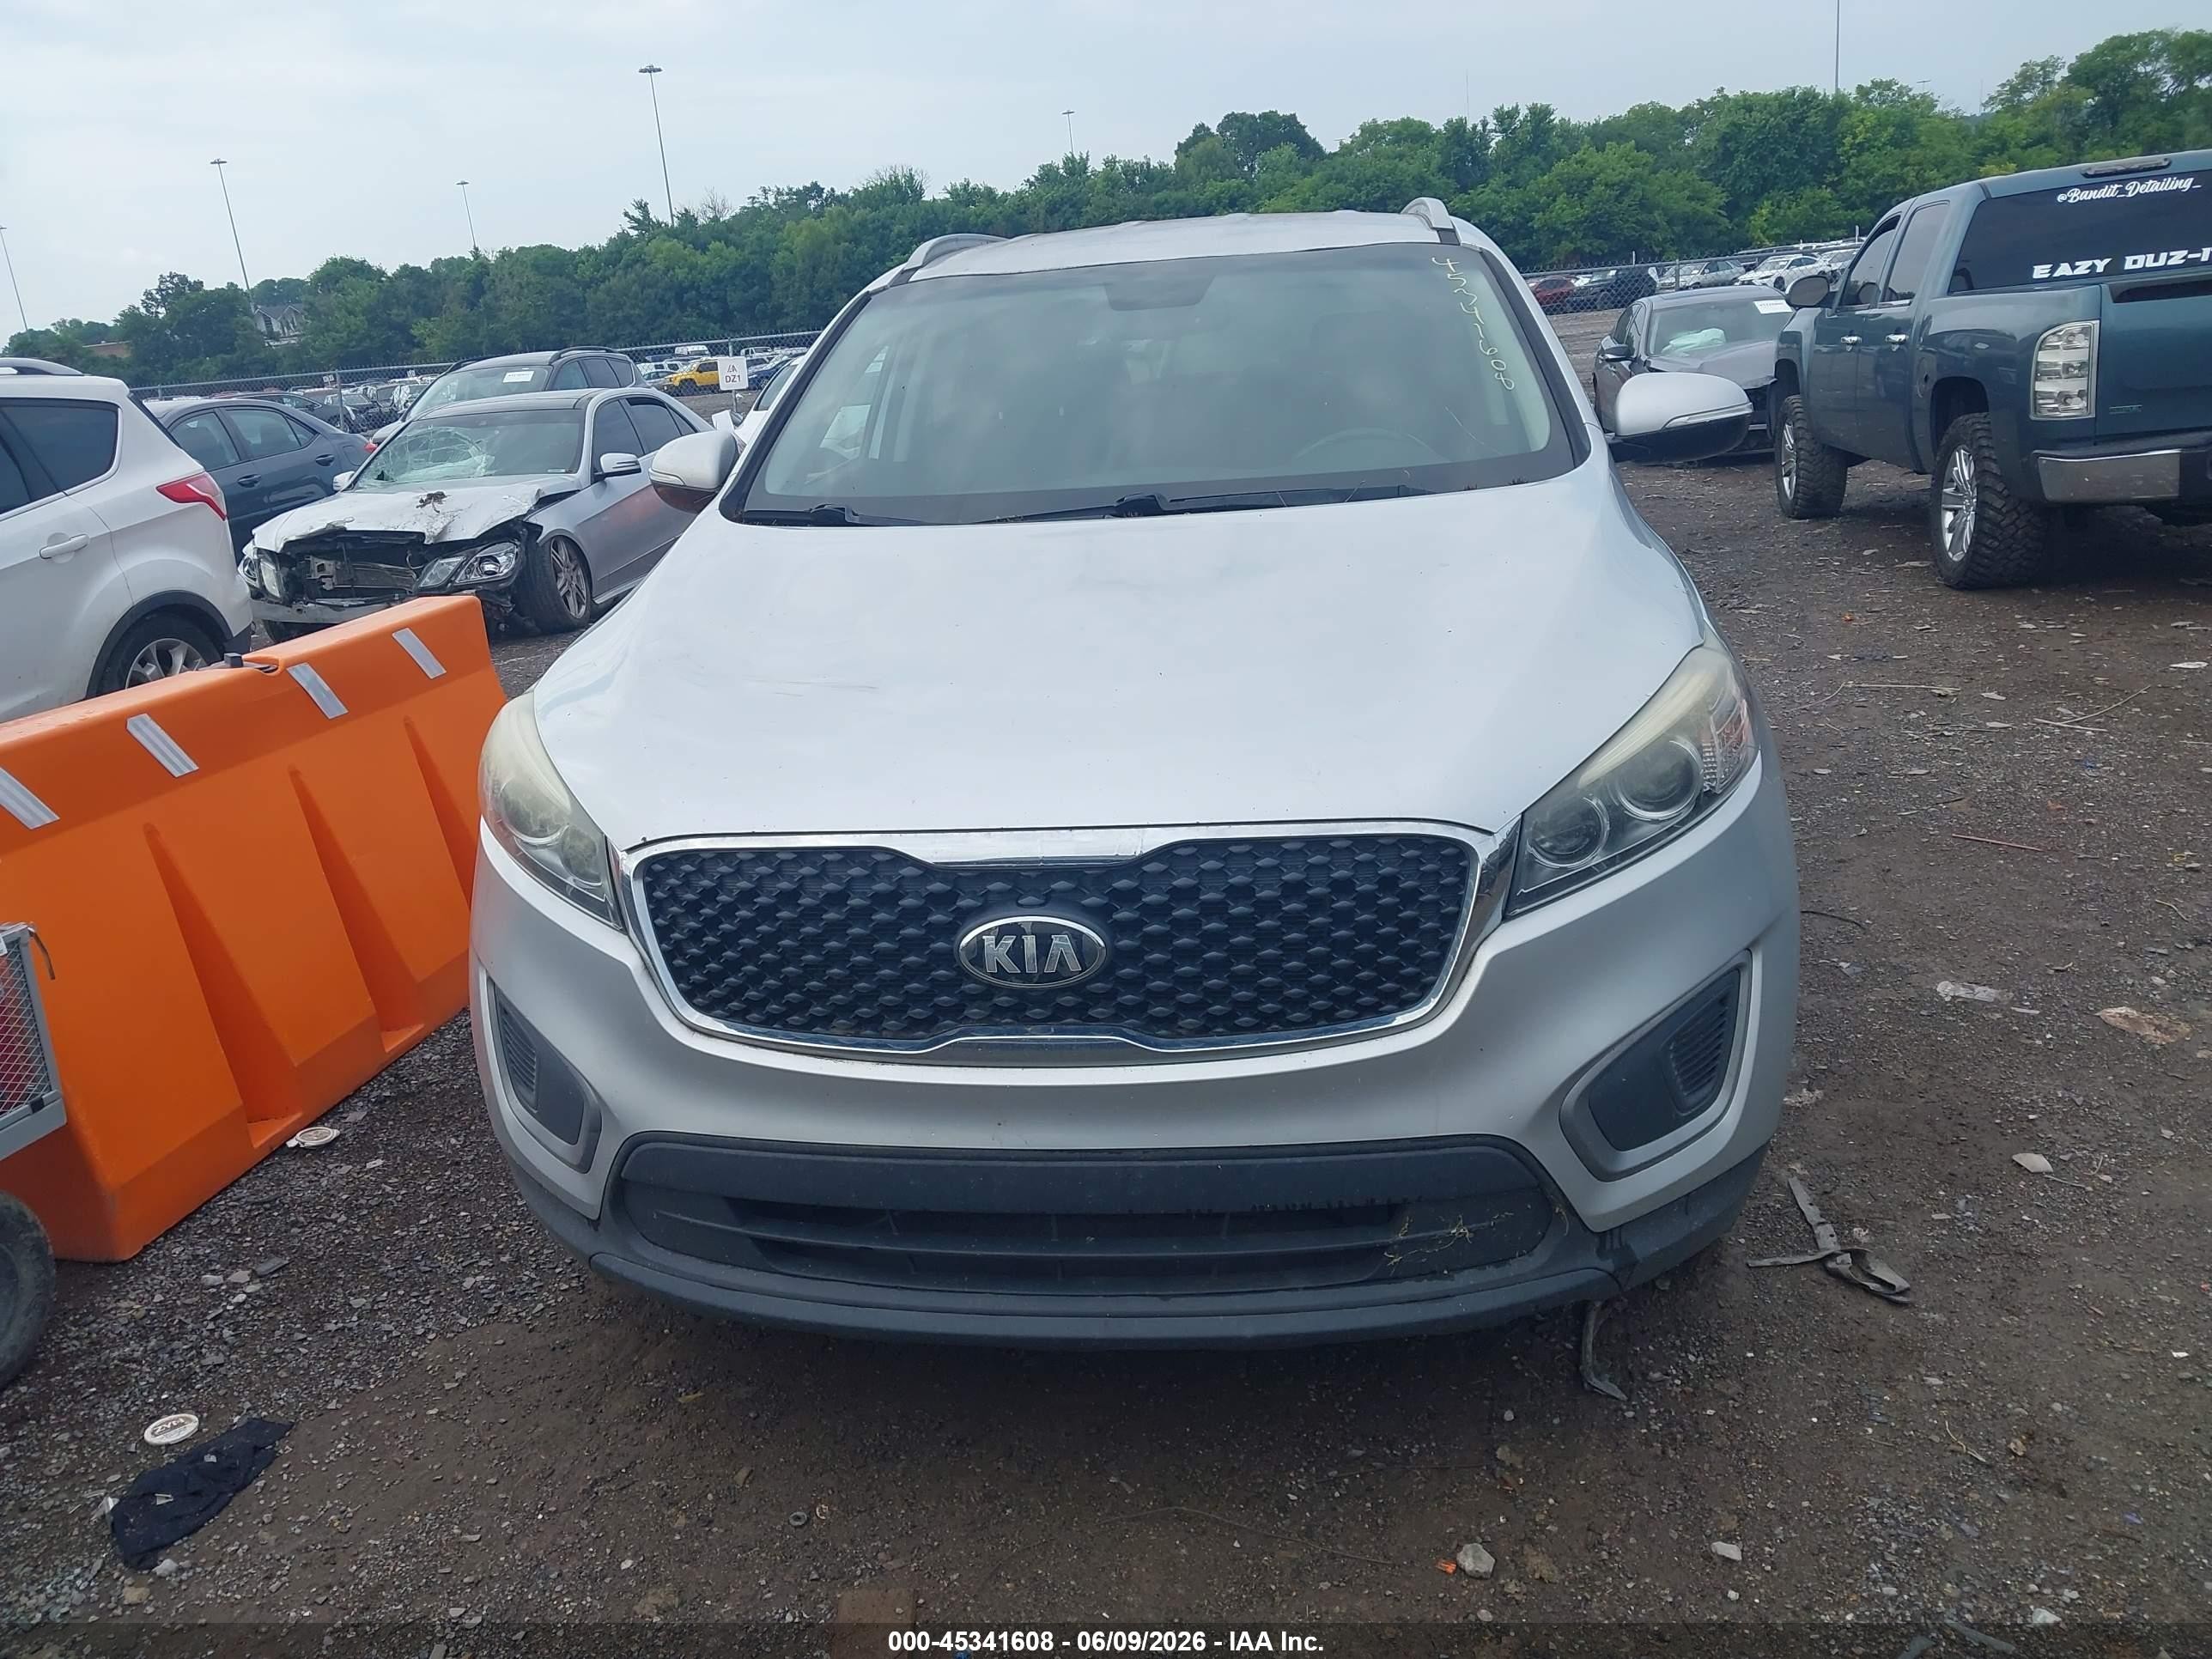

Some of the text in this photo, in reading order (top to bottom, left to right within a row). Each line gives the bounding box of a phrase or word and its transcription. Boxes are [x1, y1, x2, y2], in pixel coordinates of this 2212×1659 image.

[2057, 177, 2203, 204] @Bandit_Detailing_
[2033, 246, 2212, 279] EAZY DUZ-I
[725, 374, 741, 383] DZ1
[981, 934, 1082, 974] KIA
